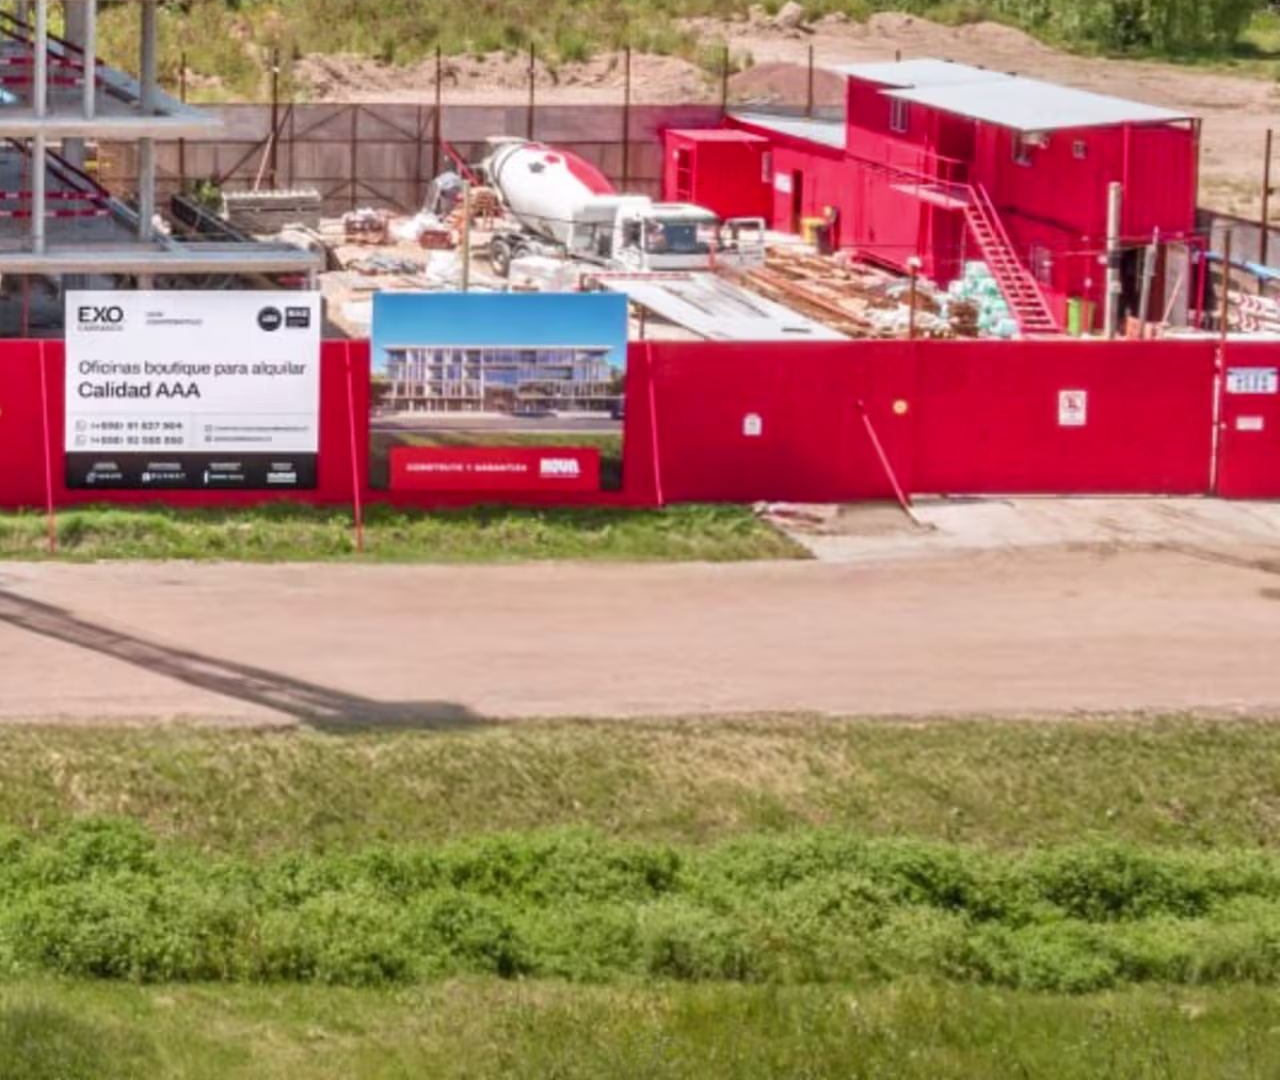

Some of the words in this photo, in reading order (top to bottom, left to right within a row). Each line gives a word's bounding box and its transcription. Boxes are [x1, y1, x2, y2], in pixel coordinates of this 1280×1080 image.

[78, 306, 124, 322] EXO
[78, 360, 140, 375] Oficinas
[144, 360, 211, 376] boutique
[214, 363, 248, 377] para
[251, 360, 306, 377] alquilar
[78, 381, 151, 398] Calidad
[155, 382, 201, 398] AAA
